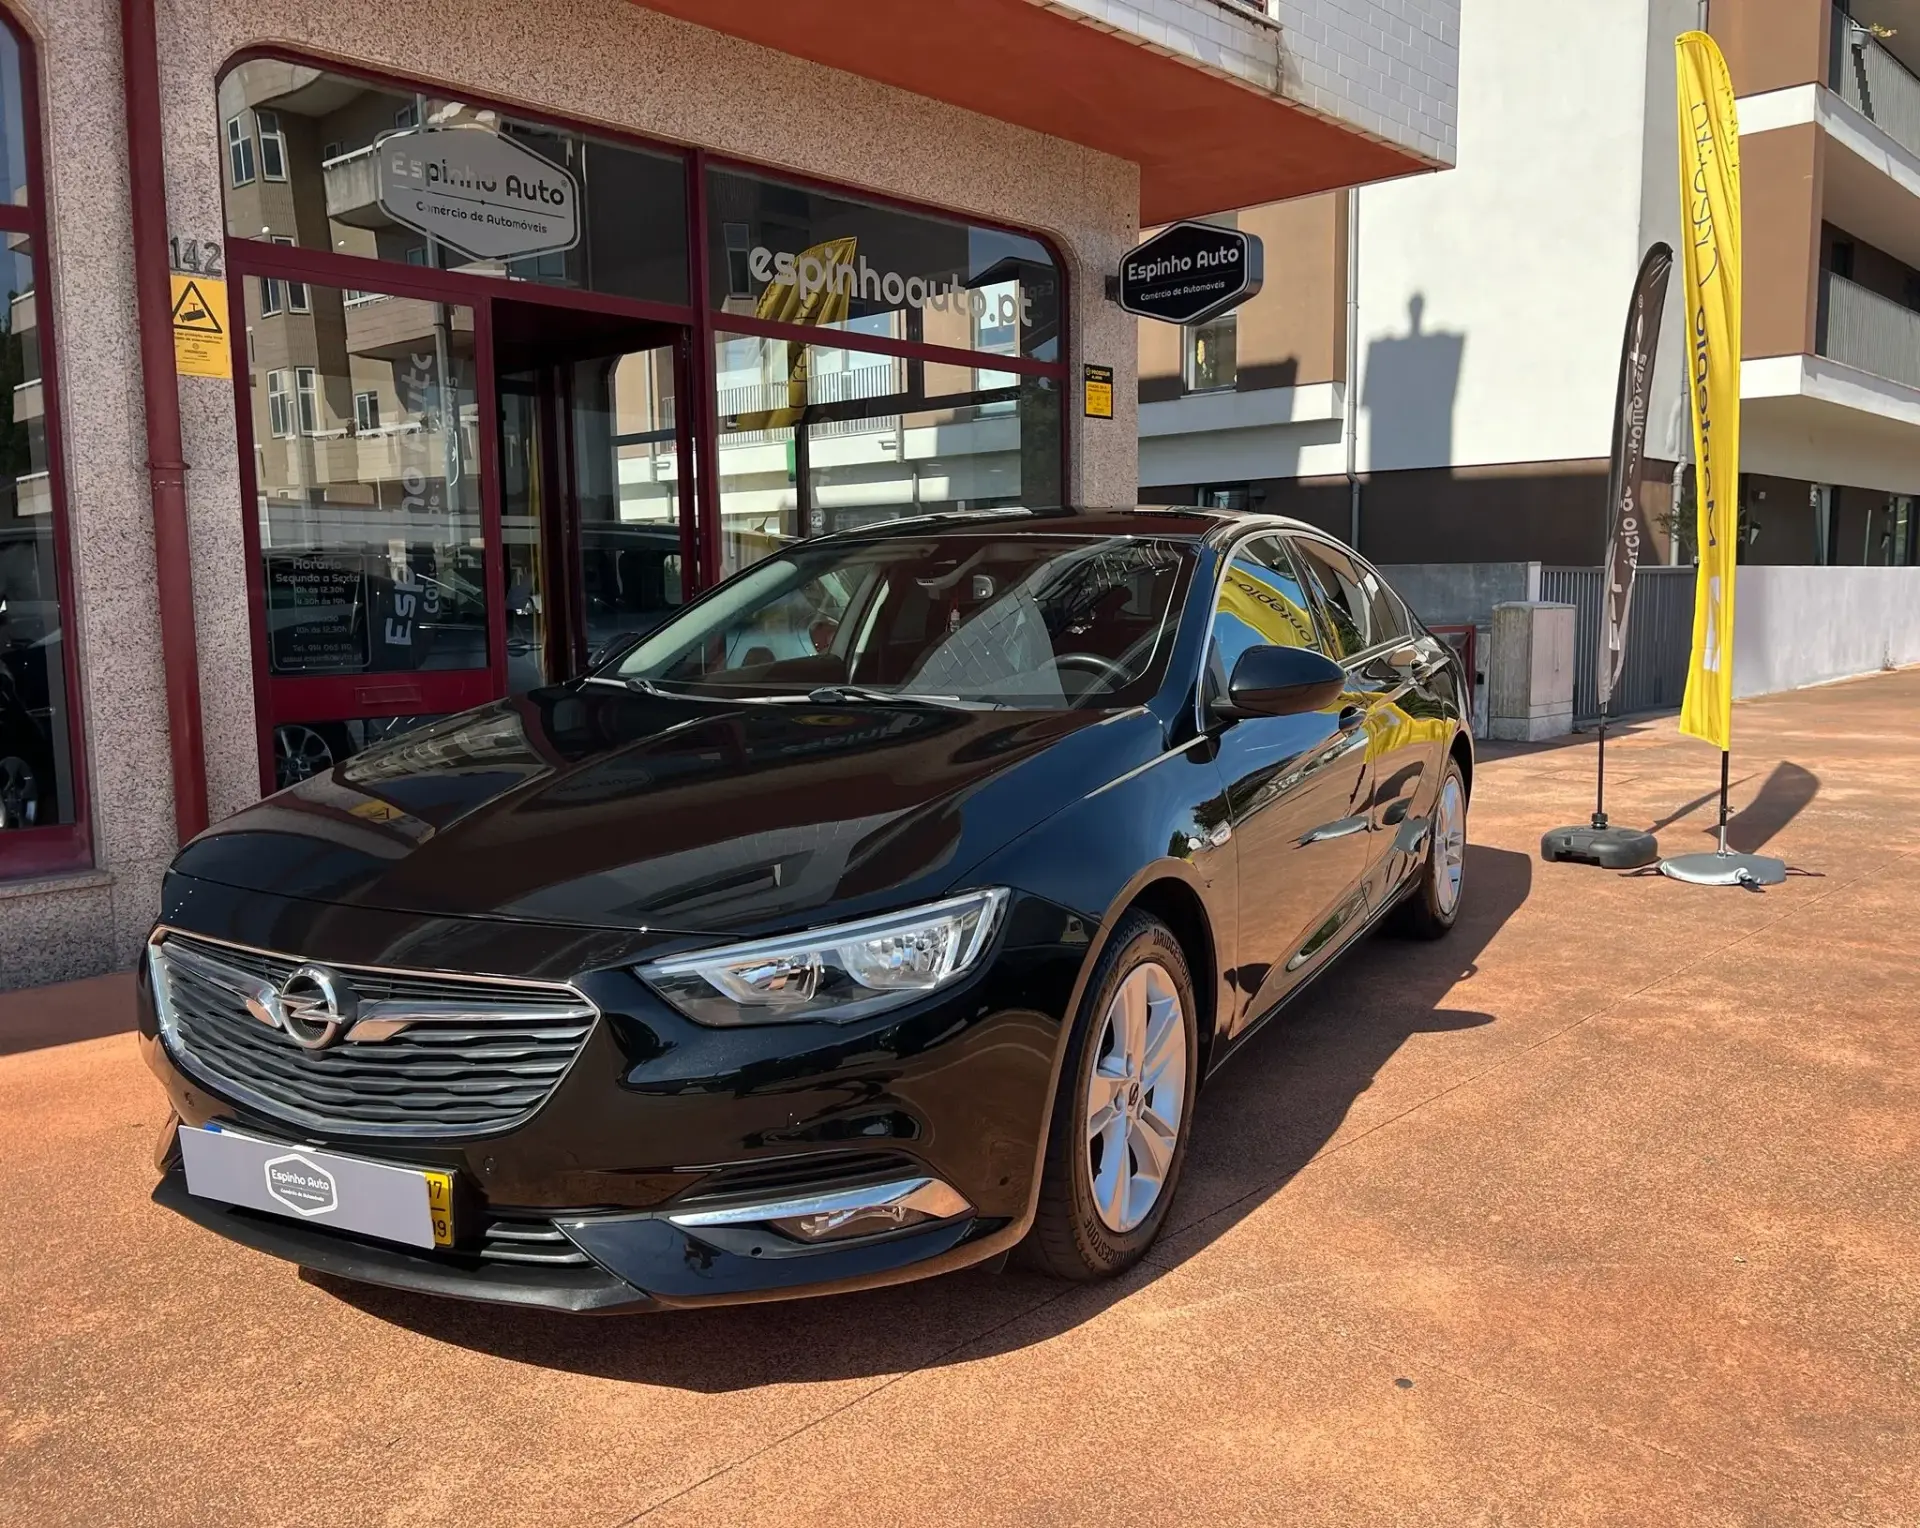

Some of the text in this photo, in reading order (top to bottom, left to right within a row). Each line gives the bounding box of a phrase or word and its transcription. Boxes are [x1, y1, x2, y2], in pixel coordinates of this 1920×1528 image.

[391, 151, 565, 206] Espinho Auto
[415, 200, 548, 235] Comércio de Automóveis
[170, 236, 222, 277] 142
[1127, 245, 1240, 282] Espinho Auto
[749, 246, 1033, 330] espinhoauto.pt
[1140, 280, 1225, 301] Comércio de Automóveis
[275, 573, 361, 585] Segunda a Sexta
[292, 556, 343, 570] Horário
[270, 1168, 330, 1191] Espinho Auto
